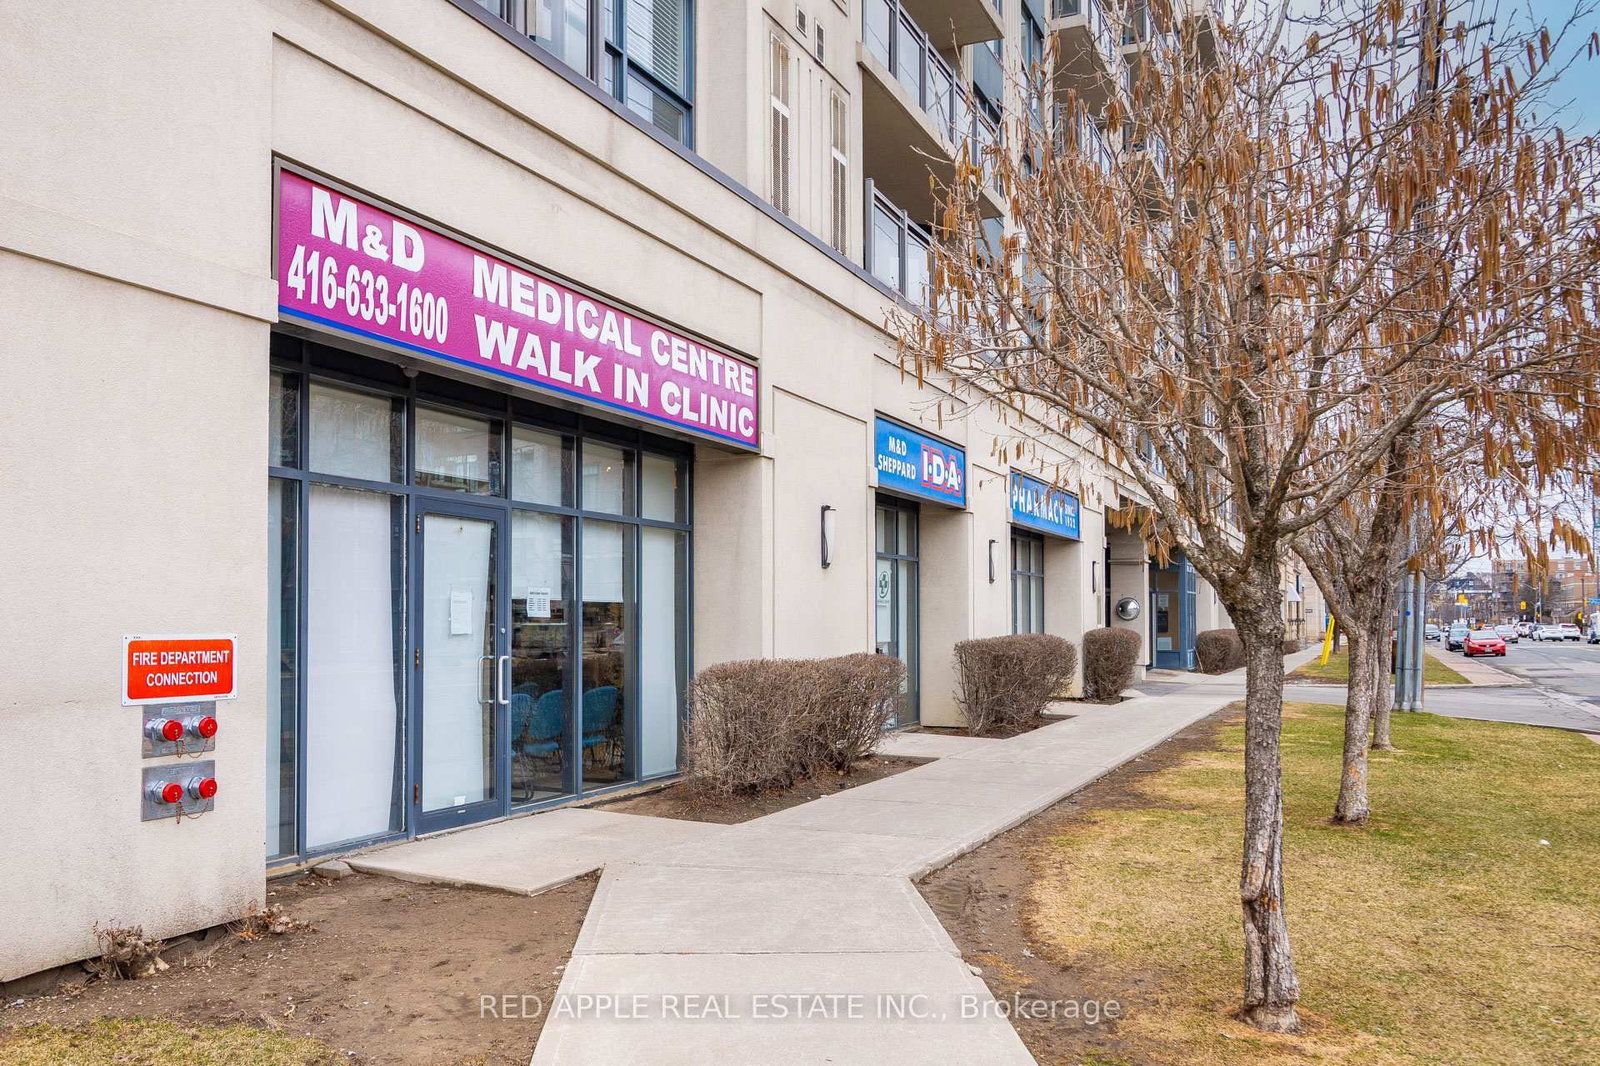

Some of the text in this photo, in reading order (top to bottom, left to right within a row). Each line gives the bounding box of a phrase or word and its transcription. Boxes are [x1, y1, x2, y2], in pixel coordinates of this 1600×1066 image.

[311, 186, 424, 273] M&D
[287, 244, 448, 344] 416-633-1600
[472, 255, 754, 398] MEDICAL CENTRE
[474, 313, 754, 438] WALK IN CLINIC
[878, 454, 916, 480] SHEPPARD
[888, 436, 907, 456] M&D
[132, 650, 230, 666] FIRE DEPARTMENT
[146, 671, 218, 687] CONNECTION
